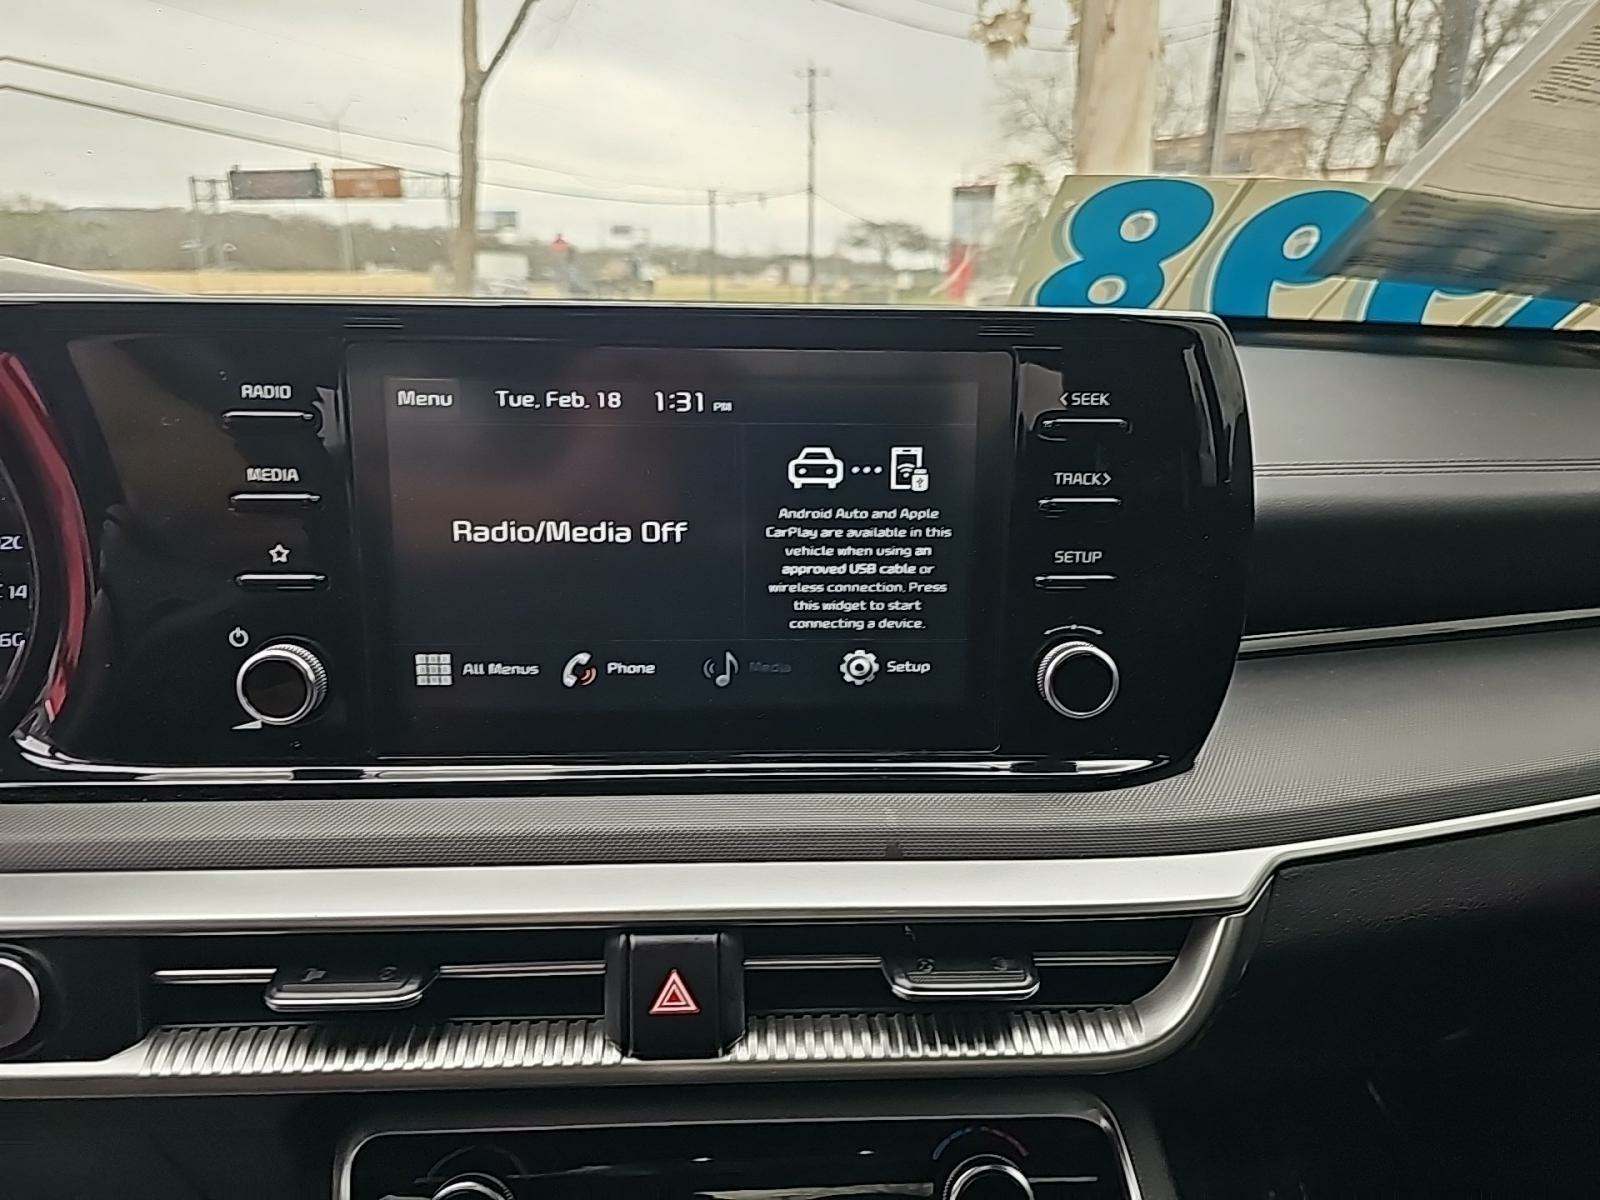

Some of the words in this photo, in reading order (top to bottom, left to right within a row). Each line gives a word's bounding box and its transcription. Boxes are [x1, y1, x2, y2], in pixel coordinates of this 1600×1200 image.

[241, 384, 292, 399] RADIO
[397, 390, 453, 407] Menu
[596, 391, 622, 409] 18
[654, 391, 704, 412] 1:31
[712, 401, 733, 412] PM
[1070, 392, 1111, 406] SEEK
[246, 467, 300, 482] MEDIA
[1053, 471, 1102, 486] TRACK
[778, 507, 833, 519] Android
[834, 507, 869, 519] Auto
[871, 508, 897, 519] and
[899, 508, 940, 521] Apple
[452, 519, 632, 543] Radio/Media
[641, 520, 689, 543] Off
[765, 526, 818, 539] CarPlay
[820, 528, 844, 538] are
[846, 526, 907, 538] available
[909, 527, 923, 538] in
[925, 526, 952, 538] this
[784, 545, 835, 557] vehicle
[837, 545, 874, 557] when
[875, 546, 912, 558] using
[914, 547, 933, 557] an
[1054, 550, 1103, 564] SETUP
[781, 562, 847, 576] approved
[848, 563, 877, 575] USB
[879, 563, 917, 575] cable
[918, 565, 935, 575] or
[768, 581, 825, 593] wireless
[908, 581, 948, 593] Press
[793, 599, 820, 611] this
[822, 599, 867, 613] widget
[869, 600, 885, 611] to
[887, 599, 922, 611] start
[788, 617, 865, 630] connecting
[867, 619, 876, 629] a
[878, 617, 927, 630] device.
[462, 662, 486, 675] All
[488, 662, 540, 675] Menus
[606, 661, 656, 674] Phone
[886, 660, 931, 674] Setup
